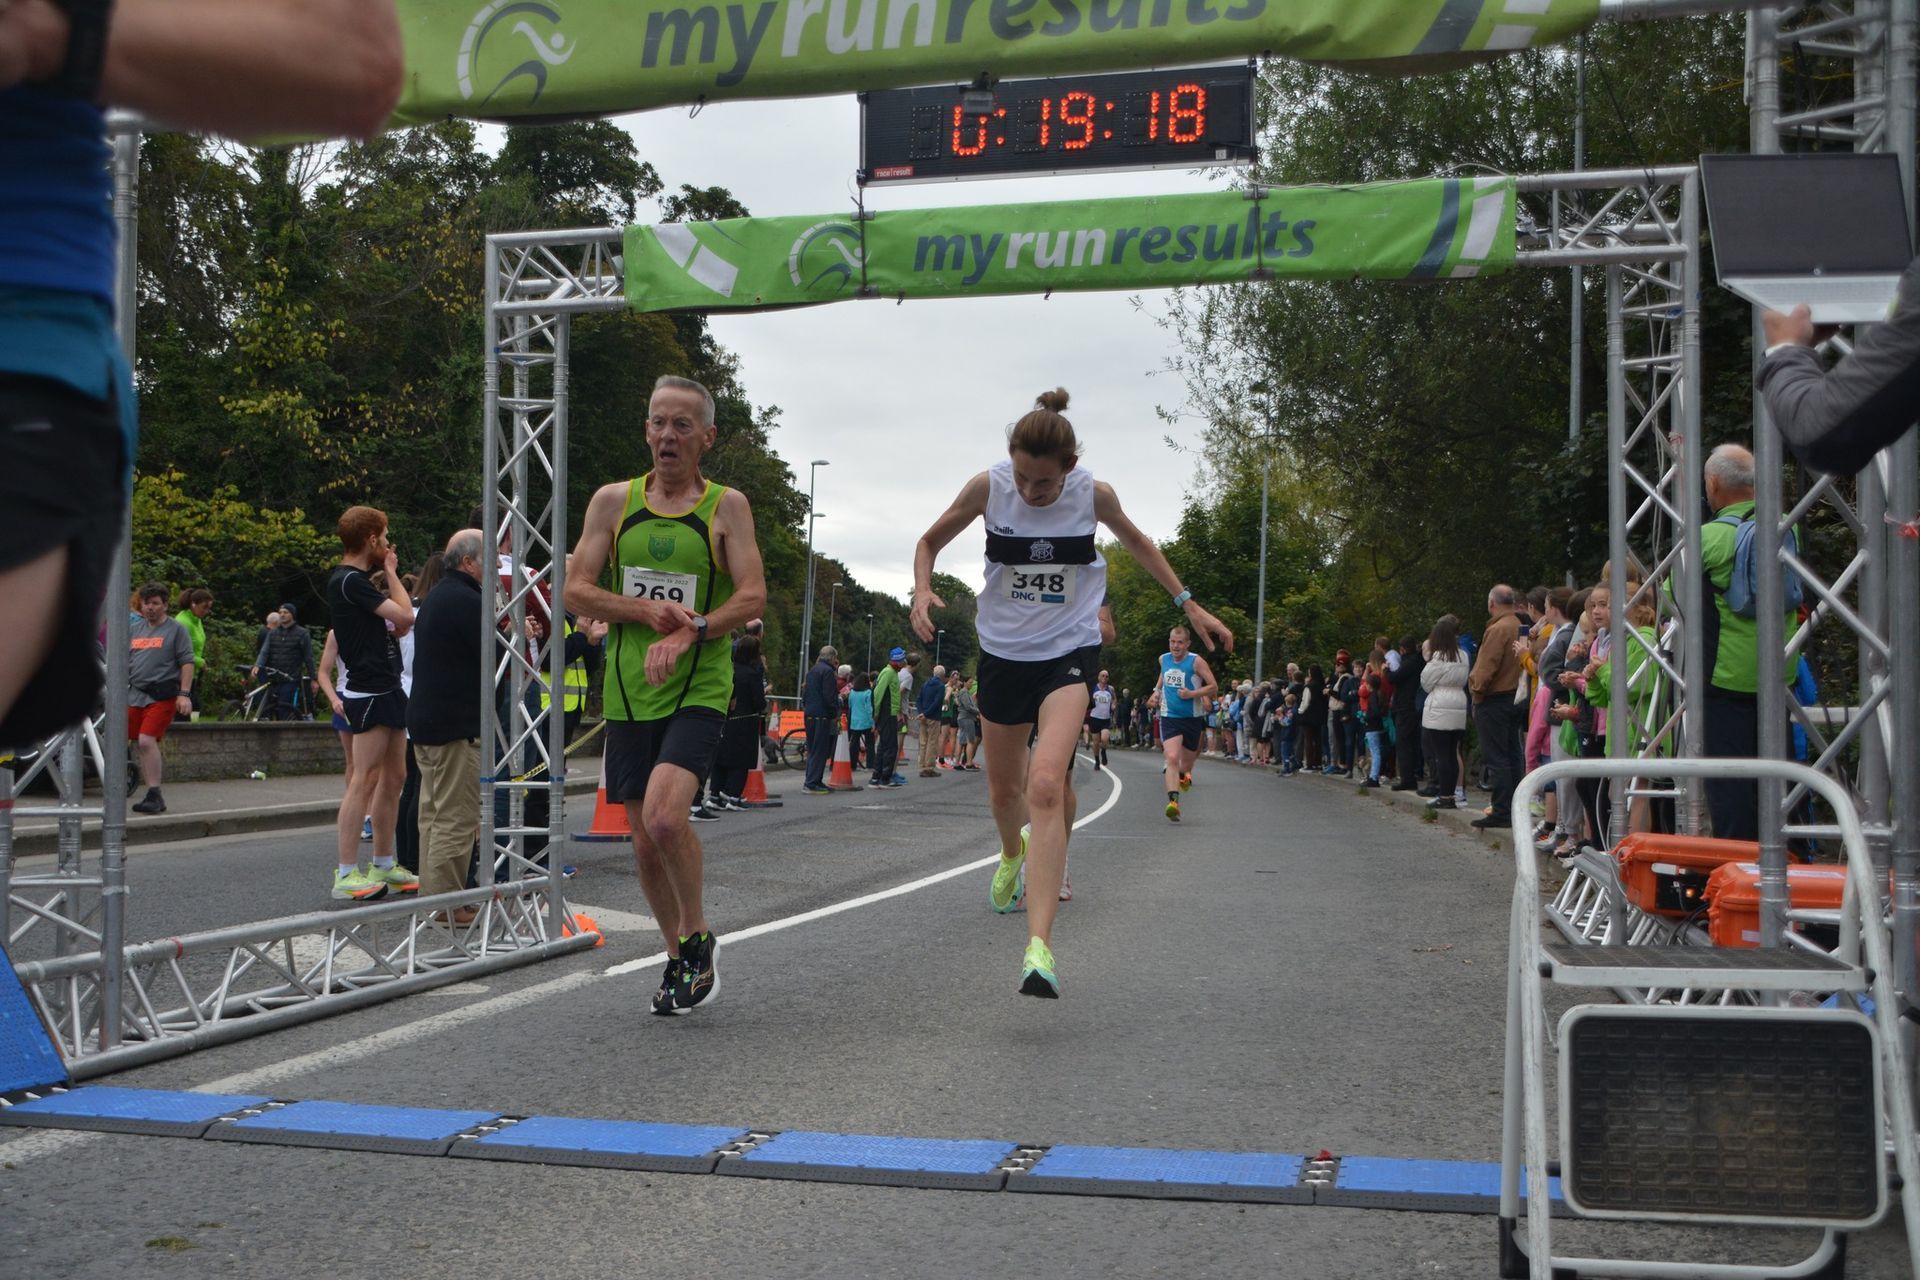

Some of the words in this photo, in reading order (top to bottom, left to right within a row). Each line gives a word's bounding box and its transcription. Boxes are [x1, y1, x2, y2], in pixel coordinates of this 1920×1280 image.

[952, 83, 1206, 156] 0:19:18
[913, 205, 1317, 286] myrunresults
[633, 582, 684, 604] 269
[1012, 571, 1065, 594] 348
[1011, 590, 1035, 601] DNG
[1167, 675, 1182, 683] 798
